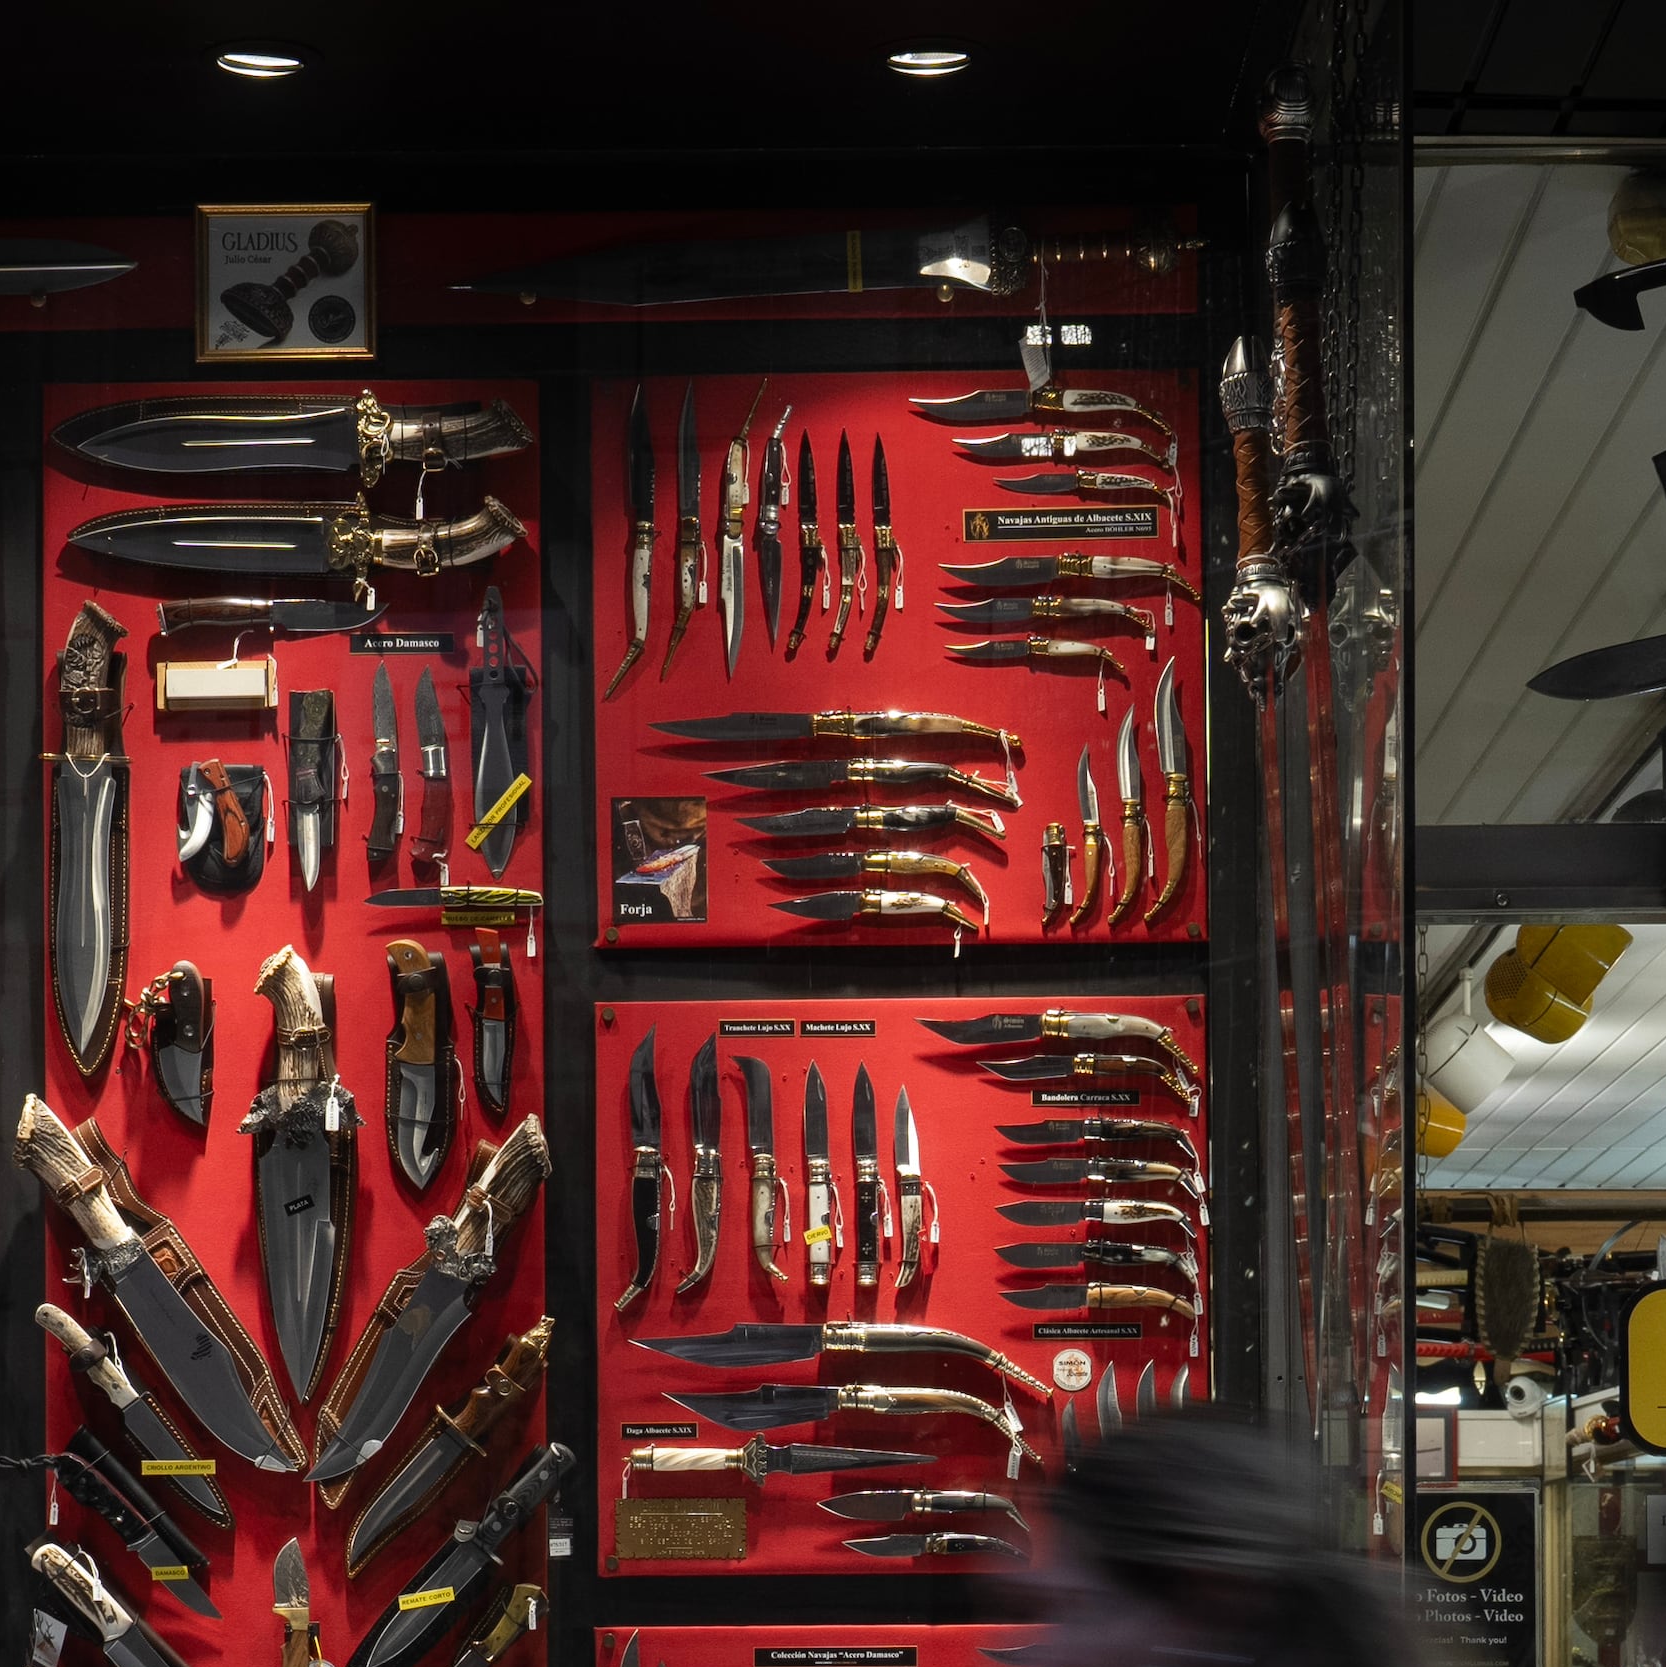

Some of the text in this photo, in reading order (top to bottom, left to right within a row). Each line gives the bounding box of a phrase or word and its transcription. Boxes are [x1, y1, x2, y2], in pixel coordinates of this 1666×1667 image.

[222, 232, 298, 253] GLADIUS
[224, 255, 245, 265] Julio
[997, 511, 1153, 526] Navajas Antiguas de Albacete S.XIX
[396, 638, 440, 648] Damasco
[620, 903, 653, 918] Forja
[805, 1023, 834, 1032] Machete
[1041, 1093, 1078, 1102] Bandolera
[146, 1463, 173, 1472] CRIOLLO
[429, 1591, 451, 1601] CORTO
[1426, 1588, 1524, 1603] Fotos Video
[1424, 1608, 1524, 1623] Photos Video
[1460, 1635, 1508, 1648] Thank you!
[771, 1649, 806, 1659] Colección
[808, 1650, 837, 1661] Navajas
